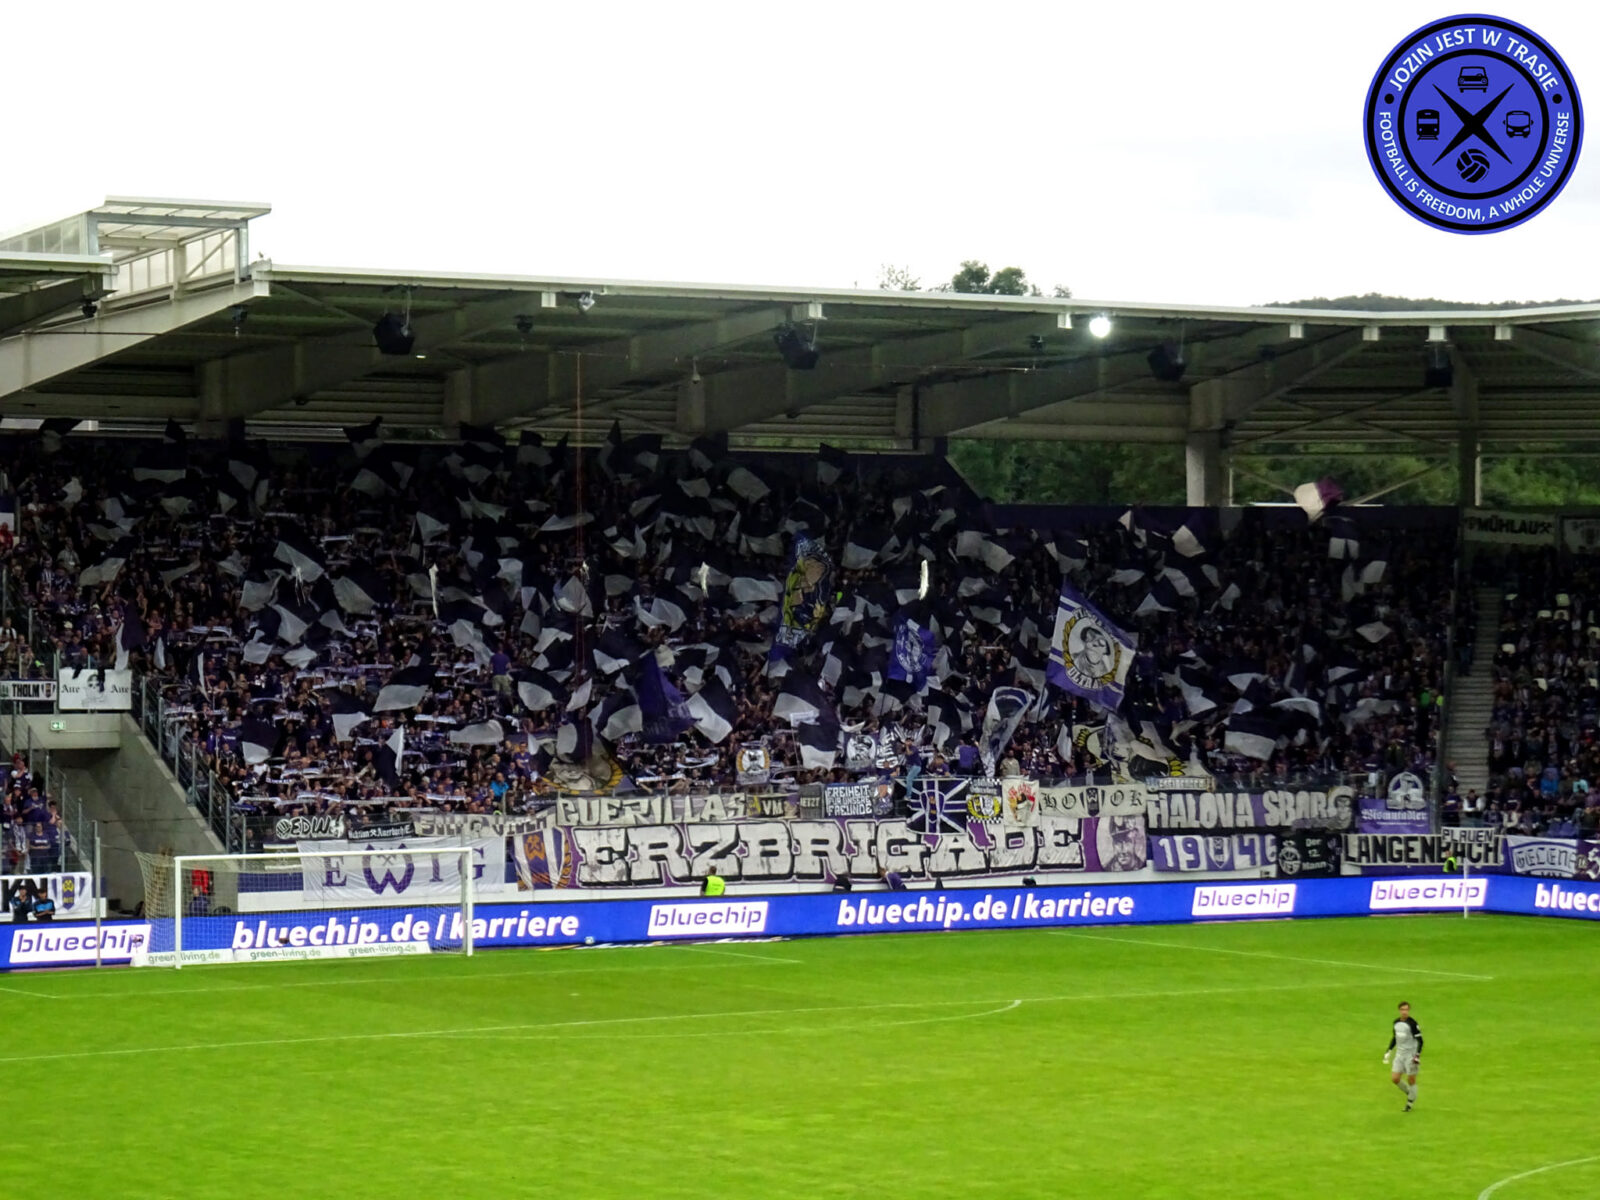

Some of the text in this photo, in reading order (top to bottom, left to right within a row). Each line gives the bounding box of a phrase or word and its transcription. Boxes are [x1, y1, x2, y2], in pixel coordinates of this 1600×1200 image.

[827, 785, 870, 800] FREIHEIT
[557, 793, 745, 826] GUERILLAS
[828, 804, 873, 816] FREUNDE
[1442, 830, 1495, 844] PLAUEN
[573, 816, 1084, 886] ERZBRIGADE
[1343, 834, 1500, 866] LANGENBACH
[1197, 889, 1290, 907] bluechip
[1375, 882, 1480, 902] bluechip
[1534, 883, 1600, 912] bluec
[654, 907, 762, 927] bluechip
[17, 929, 145, 954] bluechip
[348, 942, 417, 957] green-living.de
[148, 951, 221, 964] greenliving.de
